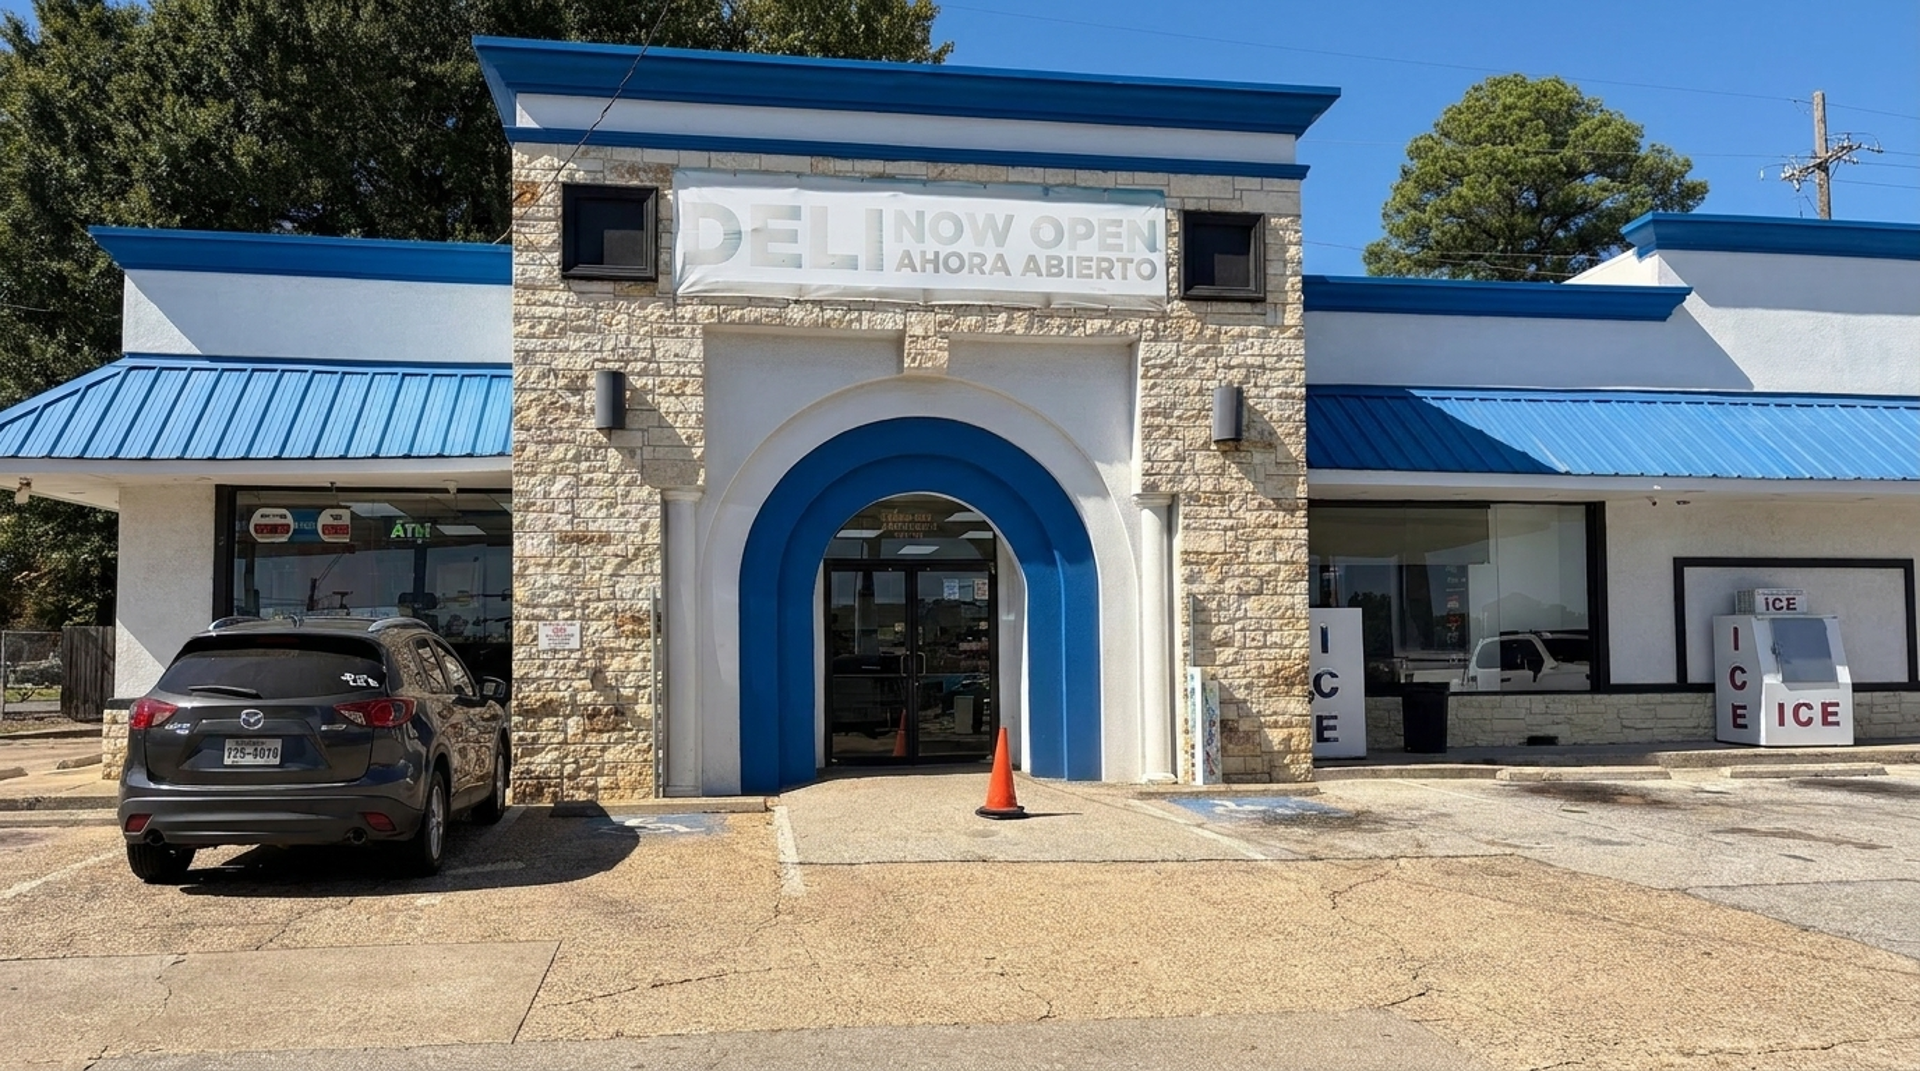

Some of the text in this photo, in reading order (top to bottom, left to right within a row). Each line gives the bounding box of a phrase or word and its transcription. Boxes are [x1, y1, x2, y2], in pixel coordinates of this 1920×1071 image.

[683, 202, 884, 271] DELI
[894, 209, 1158, 254] NOW OPEN
[894, 249, 1158, 281] AHORA ABIERTO
[391, 520, 431, 538] ATM
[1313, 623, 1339, 743] ICE
[1729, 626, 1748, 729] ICE
[1777, 702, 1840, 727] ICE
